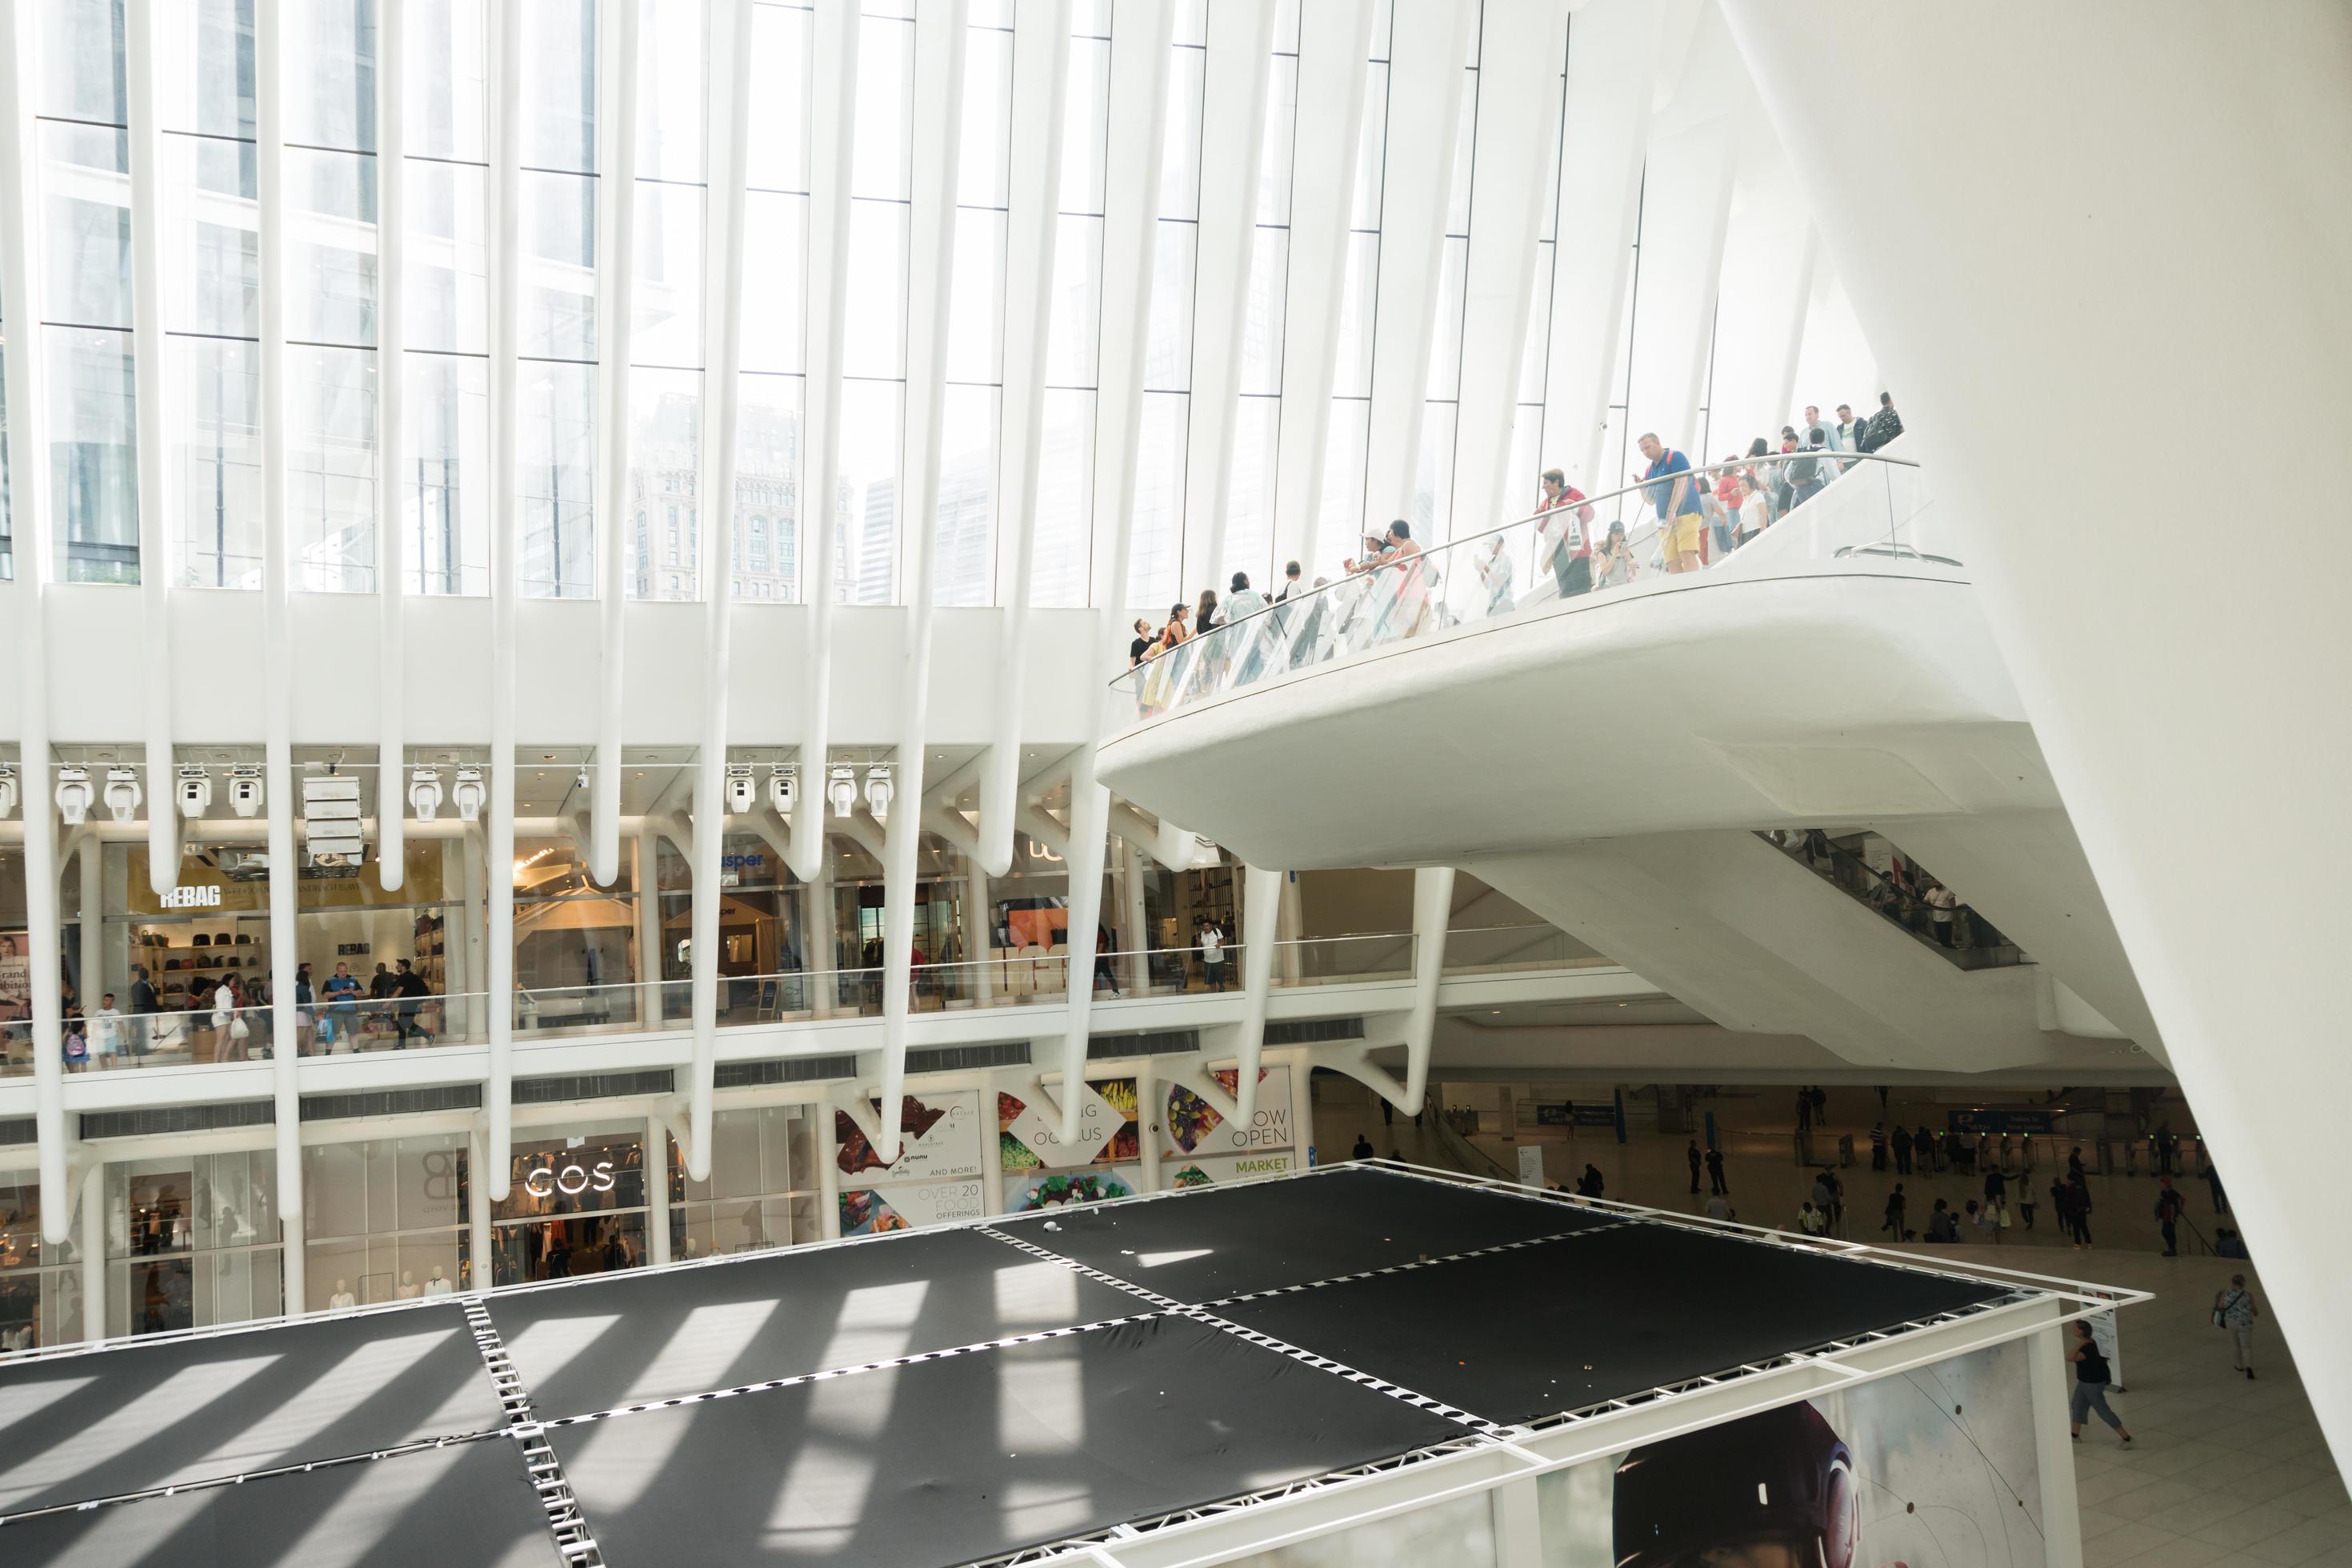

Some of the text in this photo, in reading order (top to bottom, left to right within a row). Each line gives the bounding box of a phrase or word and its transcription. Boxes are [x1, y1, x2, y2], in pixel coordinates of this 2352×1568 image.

[160, 885, 221, 908] REBAG
[338, 942, 370, 956] REBAG
[0, 969, 26, 978] rand
[1254, 1109, 1286, 1126] OW
[1034, 1127, 1102, 1145] OCUS
[1232, 1128, 1286, 1146] OPEN
[930, 1166, 977, 1176] AND MORE!
[1235, 1158, 1288, 1174] MARKET
[525, 1162, 614, 1197] COS
[918, 1184, 978, 1201] OVER 20
[935, 1197, 980, 1212] FOOD
[935, 1209, 981, 1219] OFFERINGS
